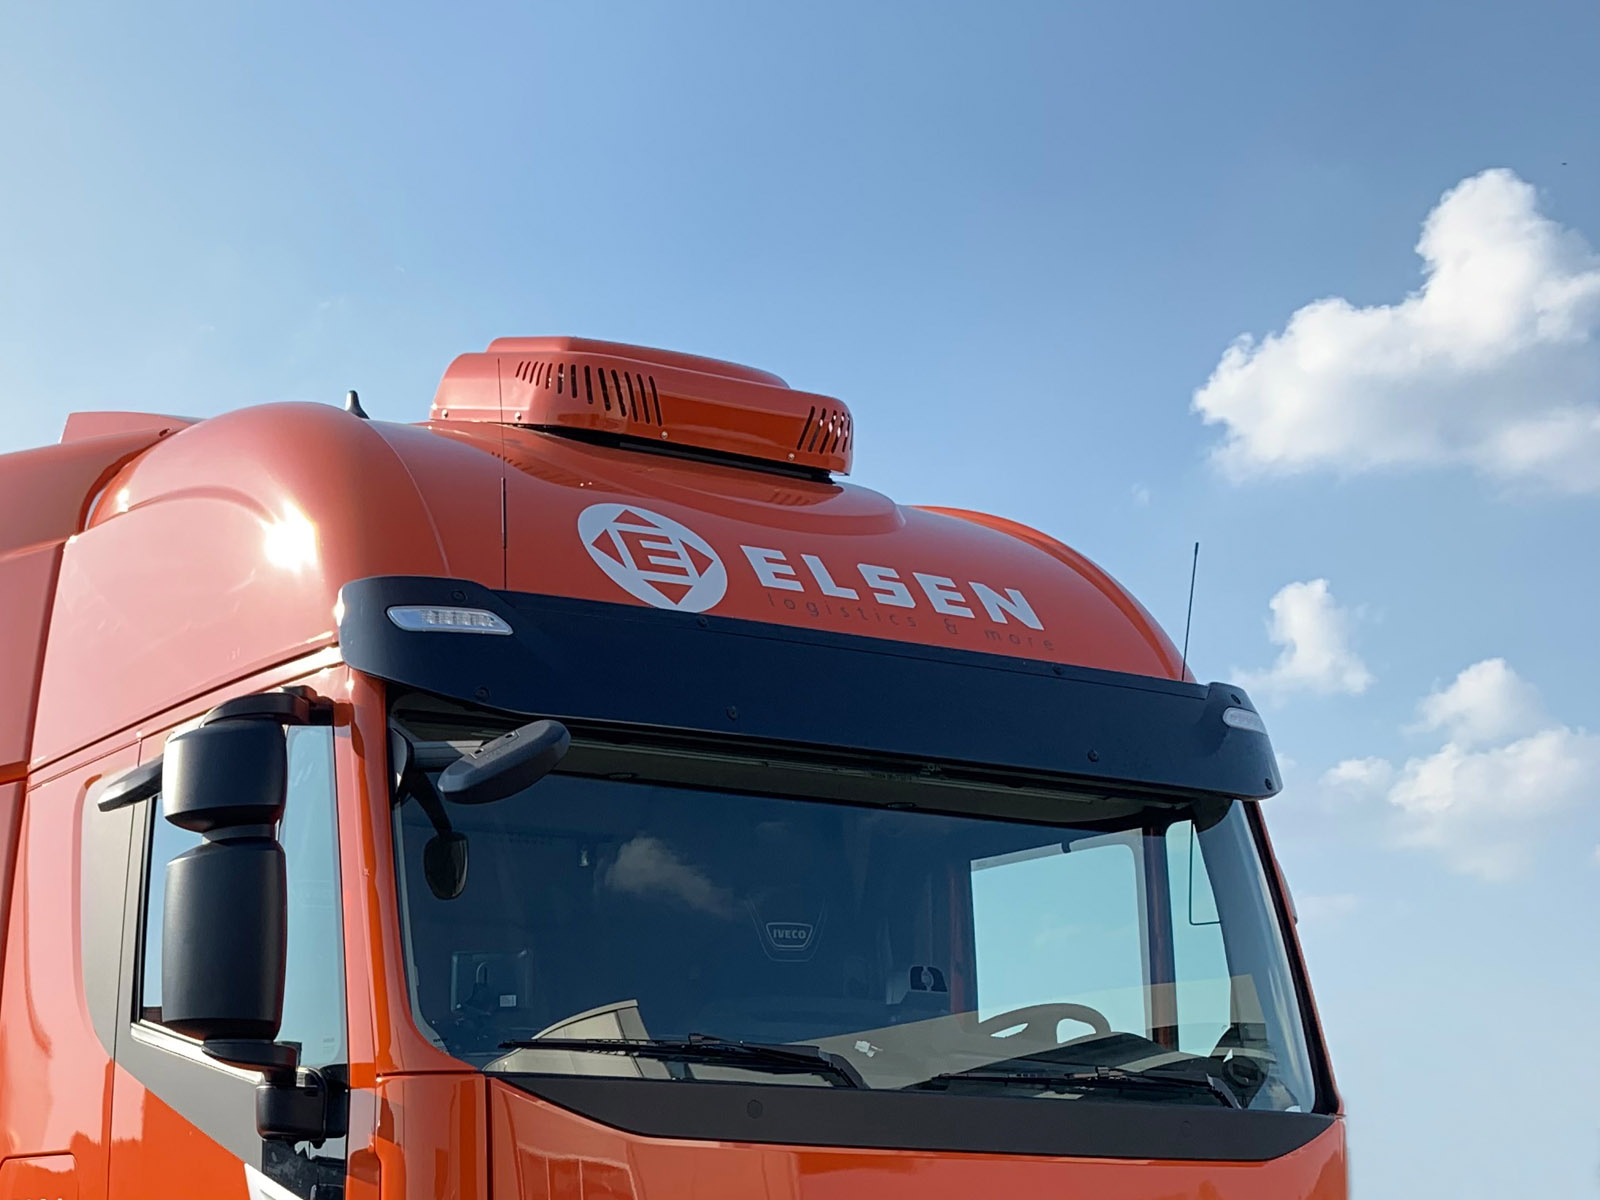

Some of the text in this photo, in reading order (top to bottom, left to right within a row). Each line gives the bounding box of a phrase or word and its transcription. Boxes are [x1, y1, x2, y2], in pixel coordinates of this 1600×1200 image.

[739, 544, 1045, 631] ELSEN
[767, 592, 1055, 651] logistics & more
[773, 928, 807, 939] IVECO
